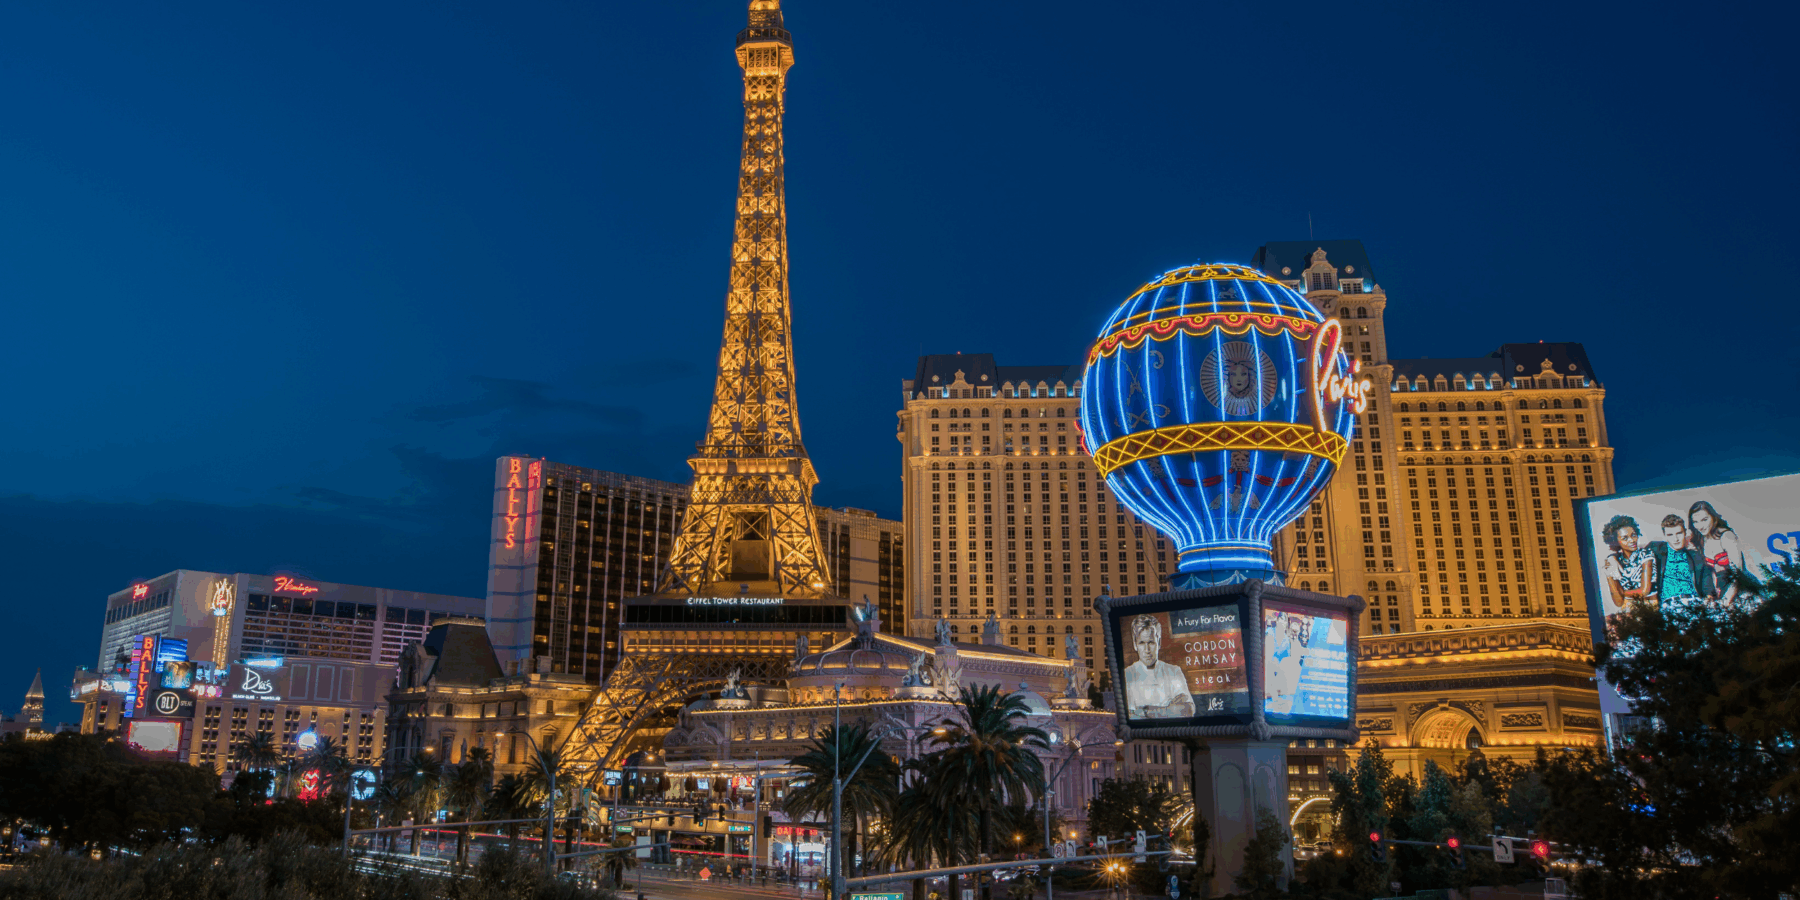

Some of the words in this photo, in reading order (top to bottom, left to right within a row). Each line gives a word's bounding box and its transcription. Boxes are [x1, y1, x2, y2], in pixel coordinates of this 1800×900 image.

[1313, 318, 1371, 432] Paris
[687, 597, 711, 605] EIFFEL
[712, 597, 738, 605] TOWER
[740, 597, 784, 605] RESTAURANT
[1178, 618, 1183, 627] A
[1184, 617, 1199, 627] Fury
[1200, 615, 1212, 625] For
[1213, 614, 1236, 624] Flavor
[1184, 639, 1236, 653] GORDON
[1185, 652, 1236, 666] RAMSAY
[1195, 673, 1231, 685] steak
[161, 696, 175, 709] BLT
